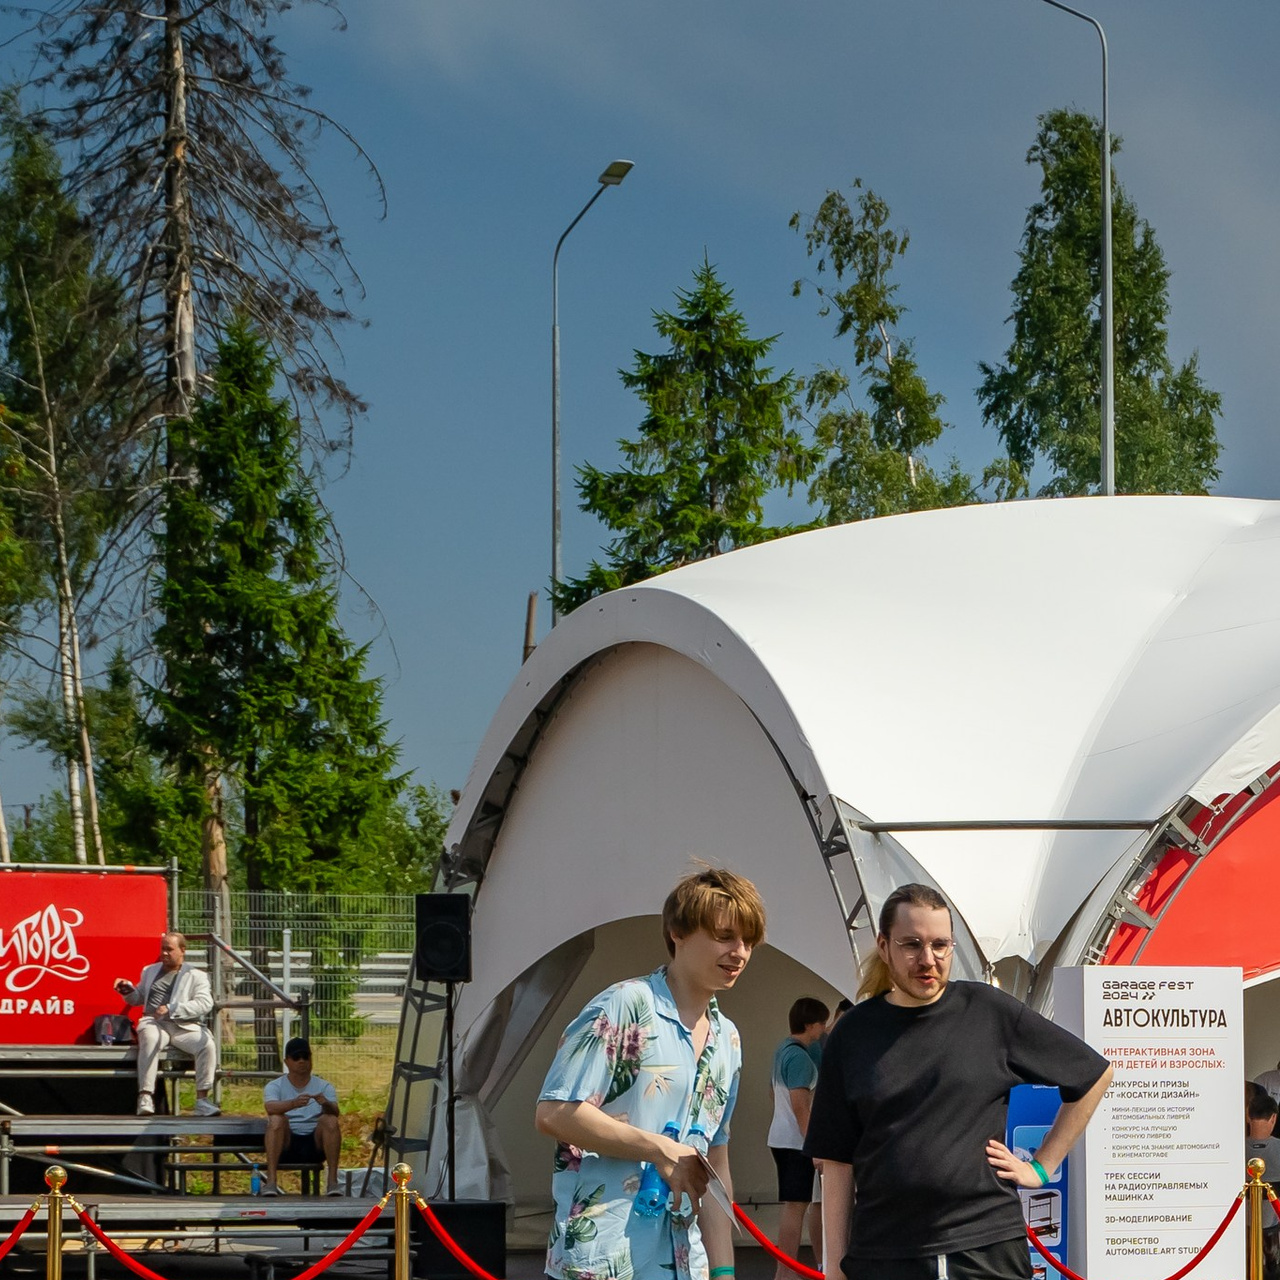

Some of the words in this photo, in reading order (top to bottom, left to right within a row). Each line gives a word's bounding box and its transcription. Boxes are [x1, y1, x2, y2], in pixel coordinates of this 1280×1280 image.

[1102, 991, 1139, 1000] 2024
[1102, 1008, 1228, 1028] АВТОКУЛЬТУРА
[1103, 1047, 1187, 1057] ИНТЕРАКТИВНАЯ
[1189, 1047, 1216, 1056] ЗОНА
[1111, 1060, 1124, 1069] ЛЯ
[1125, 1058, 1158, 1070] ДЕТЕЙ
[1160, 1060, 1167, 1069] И
[1169, 1060, 1226, 1069] ВЗРОСЛЫХ:
[1109, 1080, 1151, 1089] ОНКУРСЫ
[1152, 1080, 1158, 1088] И
[1159, 1080, 1190, 1088] ПРИЗЫ
[1103, 1091, 1115, 1099] ОТ
[1116, 1091, 1160, 1099] «КОСАТКИ
[1160, 1089, 1201, 1100] ДИЗАЙН»
[1175, 1142, 1221, 1150] АВТОМОБИЛЕЙ
[1104, 1172, 1126, 1180] ТРЕК
[1127, 1172, 1161, 1180] СЕССИИ
[1104, 1183, 1117, 1191] НА
[1118, 1182, 1209, 1192] РАДИОУПРАВЛЯЕМЫХ
[1104, 1193, 1155, 1202] МАШИНКАХ
[1104, 1214, 1193, 1224] 3D-МОДЕЛИРОВАНИЕ
[1105, 1236, 1160, 1246] ТВОРЧЕСТВО
